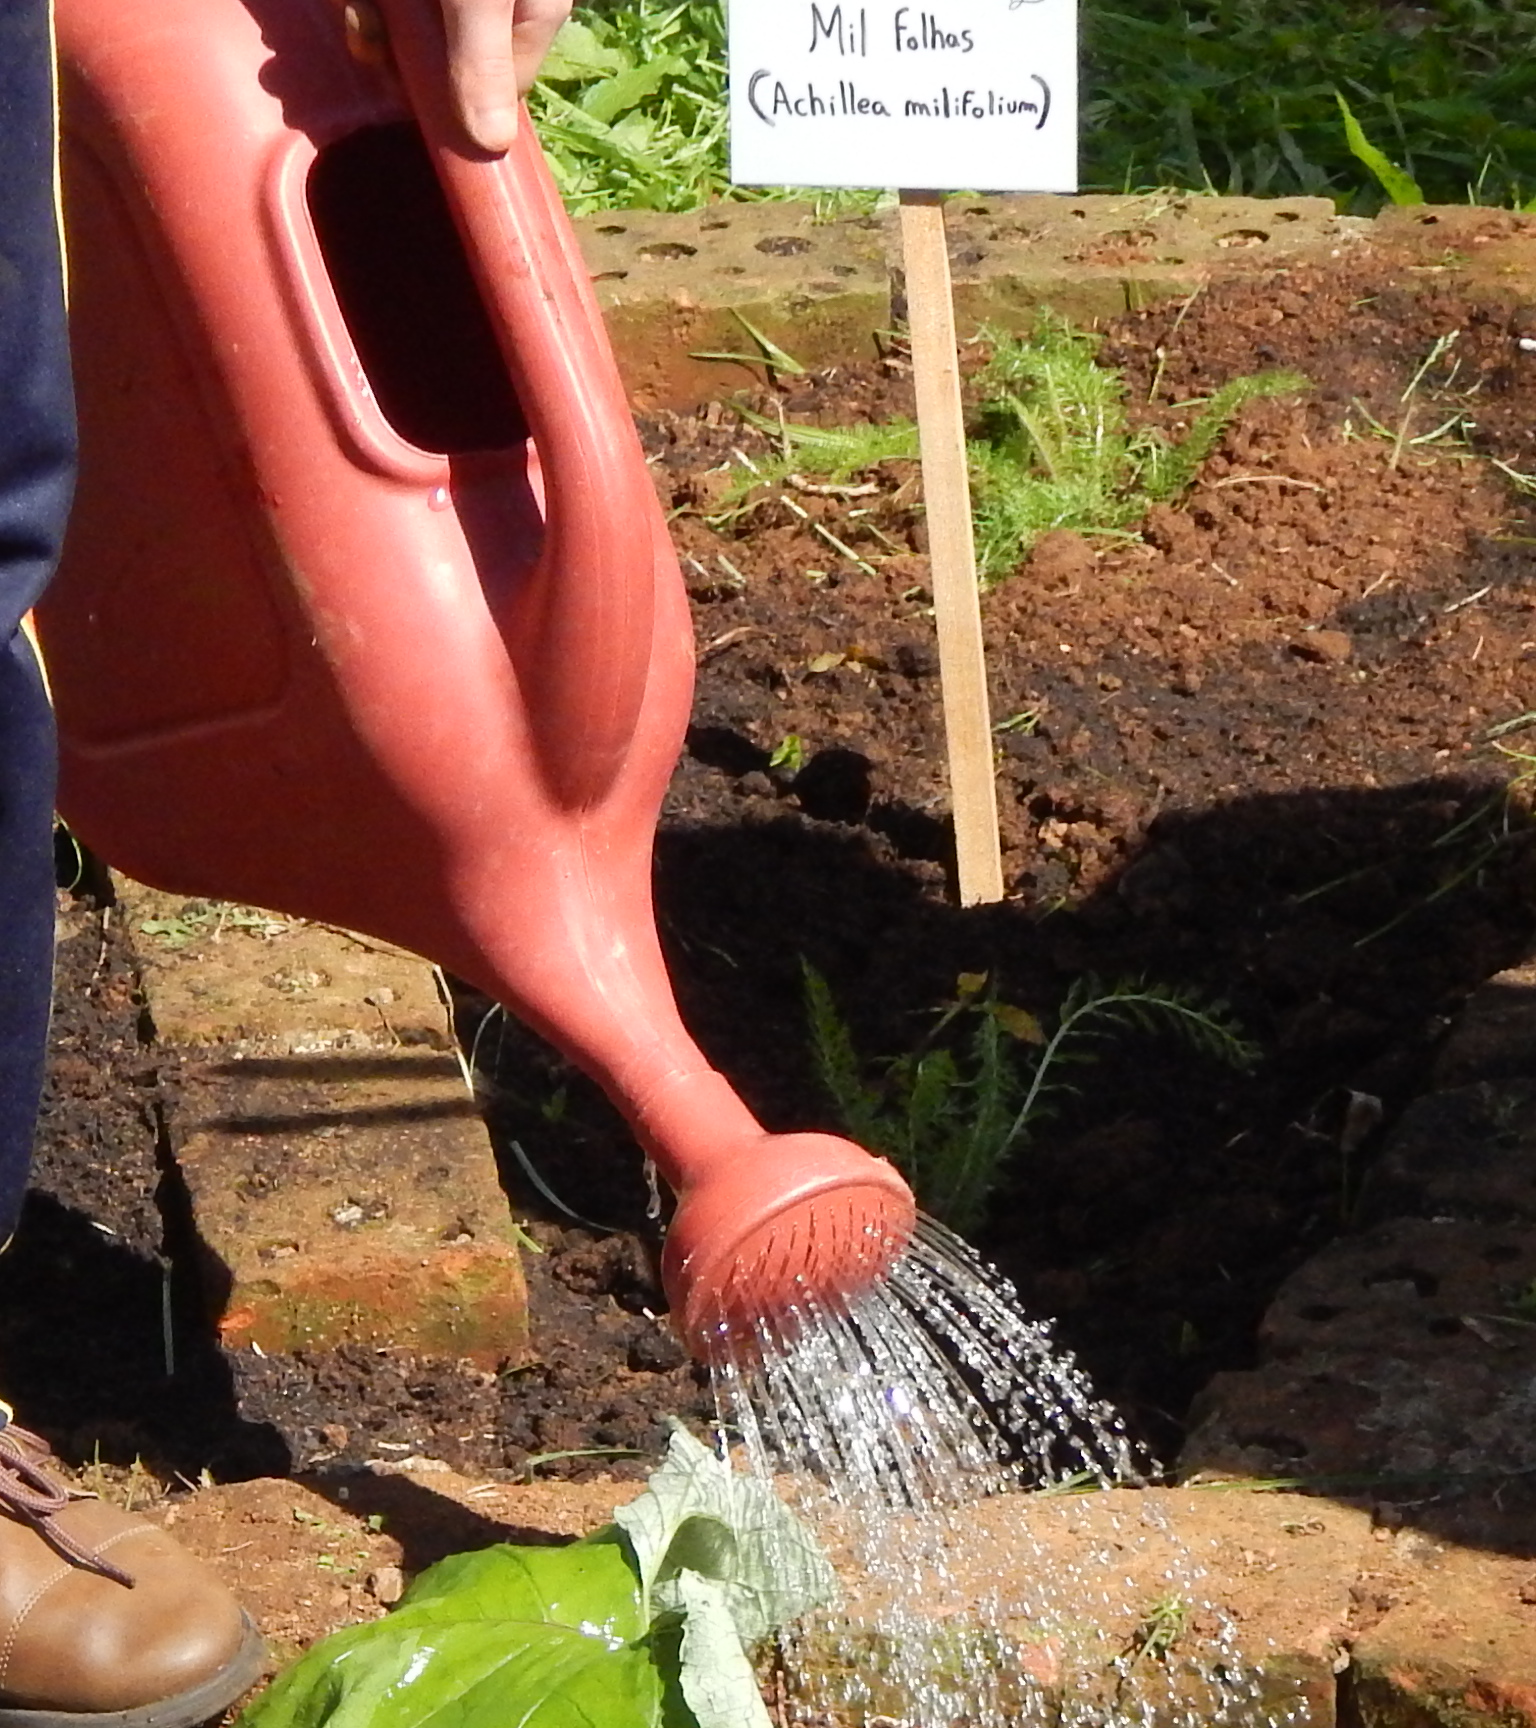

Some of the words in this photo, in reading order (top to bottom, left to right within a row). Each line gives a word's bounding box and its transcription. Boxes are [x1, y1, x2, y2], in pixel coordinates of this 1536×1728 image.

[808, 2, 867, 57] Mil
[895, 6, 975, 53] Folhas
[747, 69, 891, 127] (Achillea
[904, 73, 1051, 130] milifolium)
